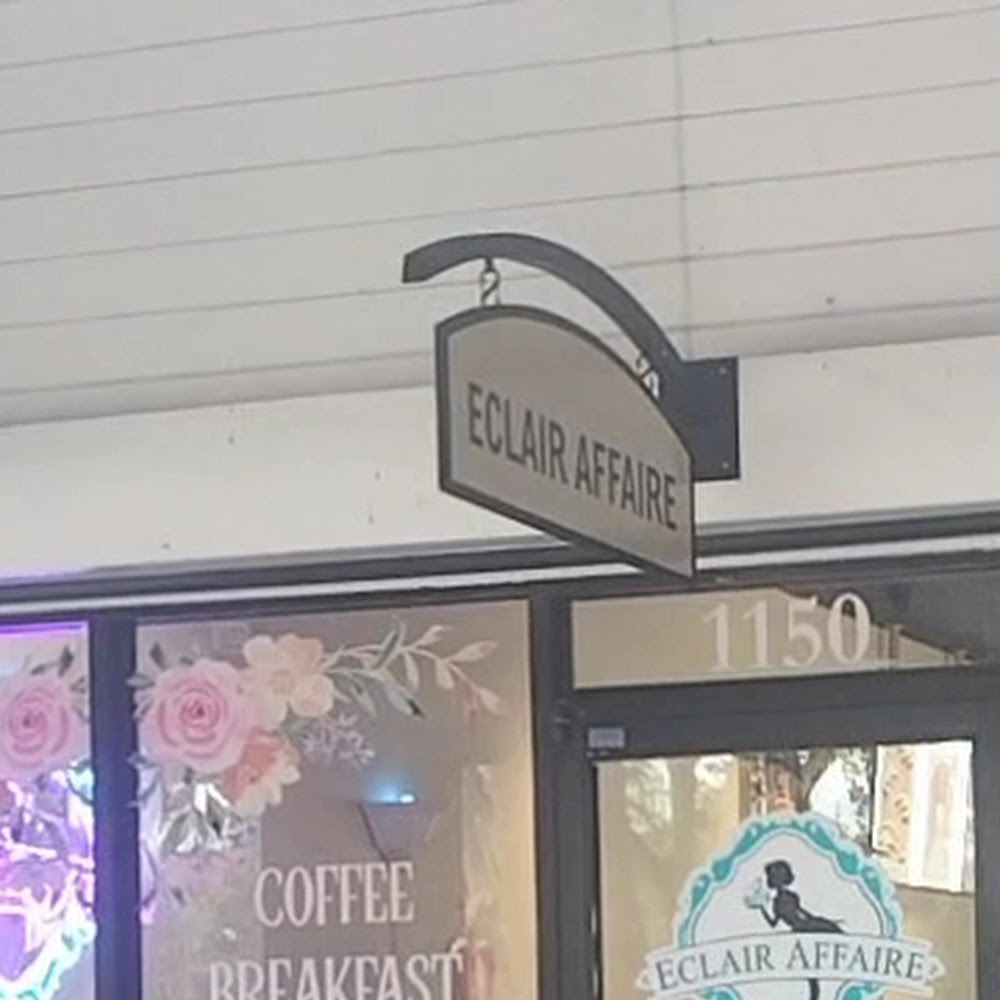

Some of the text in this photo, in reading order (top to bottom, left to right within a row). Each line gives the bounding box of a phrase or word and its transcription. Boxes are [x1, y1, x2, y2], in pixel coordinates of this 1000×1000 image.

[467, 382, 678, 531] ECLAIR AFFAIRE
[703, 592, 870, 673] 1150
[254, 861, 415, 928] COFFEE
[655, 938, 924, 990] ECLAIR AFFAIRE
